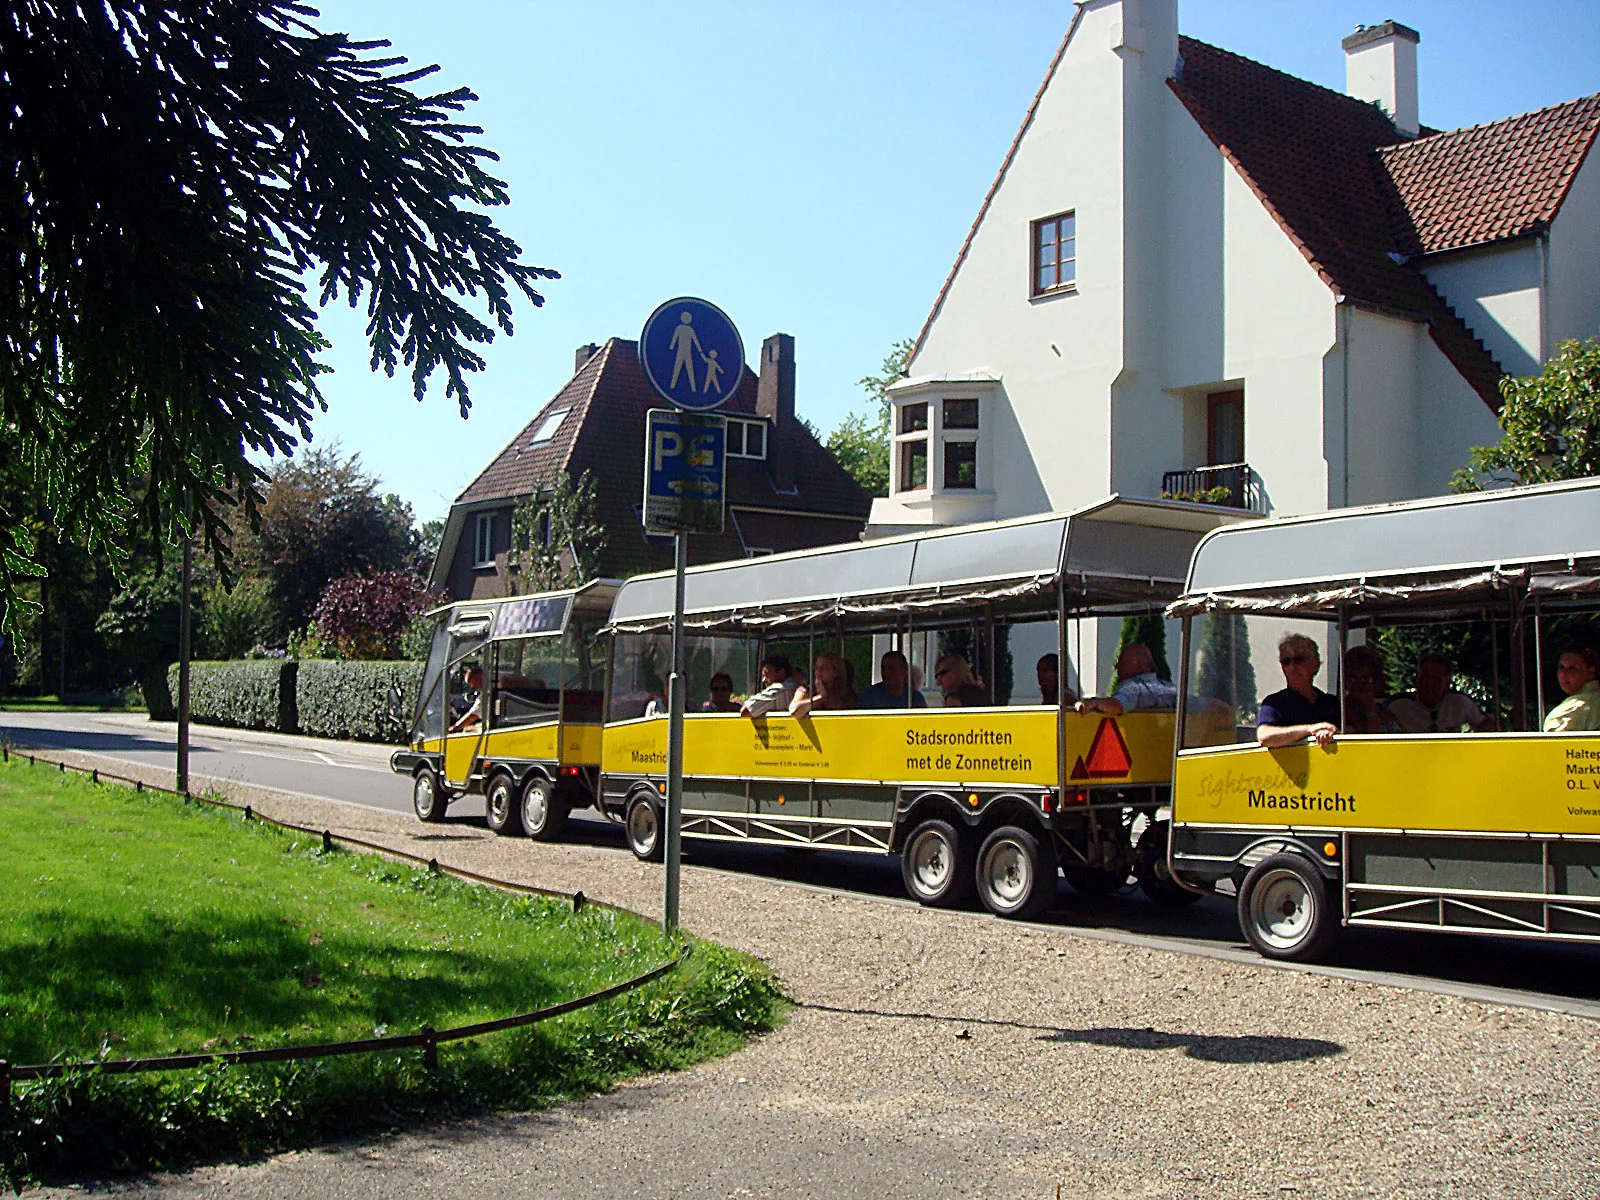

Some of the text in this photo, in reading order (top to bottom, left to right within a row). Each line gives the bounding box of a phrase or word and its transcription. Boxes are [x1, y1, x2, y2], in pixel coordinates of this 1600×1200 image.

[654, 430, 684, 472] P
[906, 729, 1013, 746] Stadsrondritten
[631, 750, 668, 765] Maastric
[906, 753, 1033, 771] met de Zonnetrein
[1248, 789, 1357, 813] Maastricht
